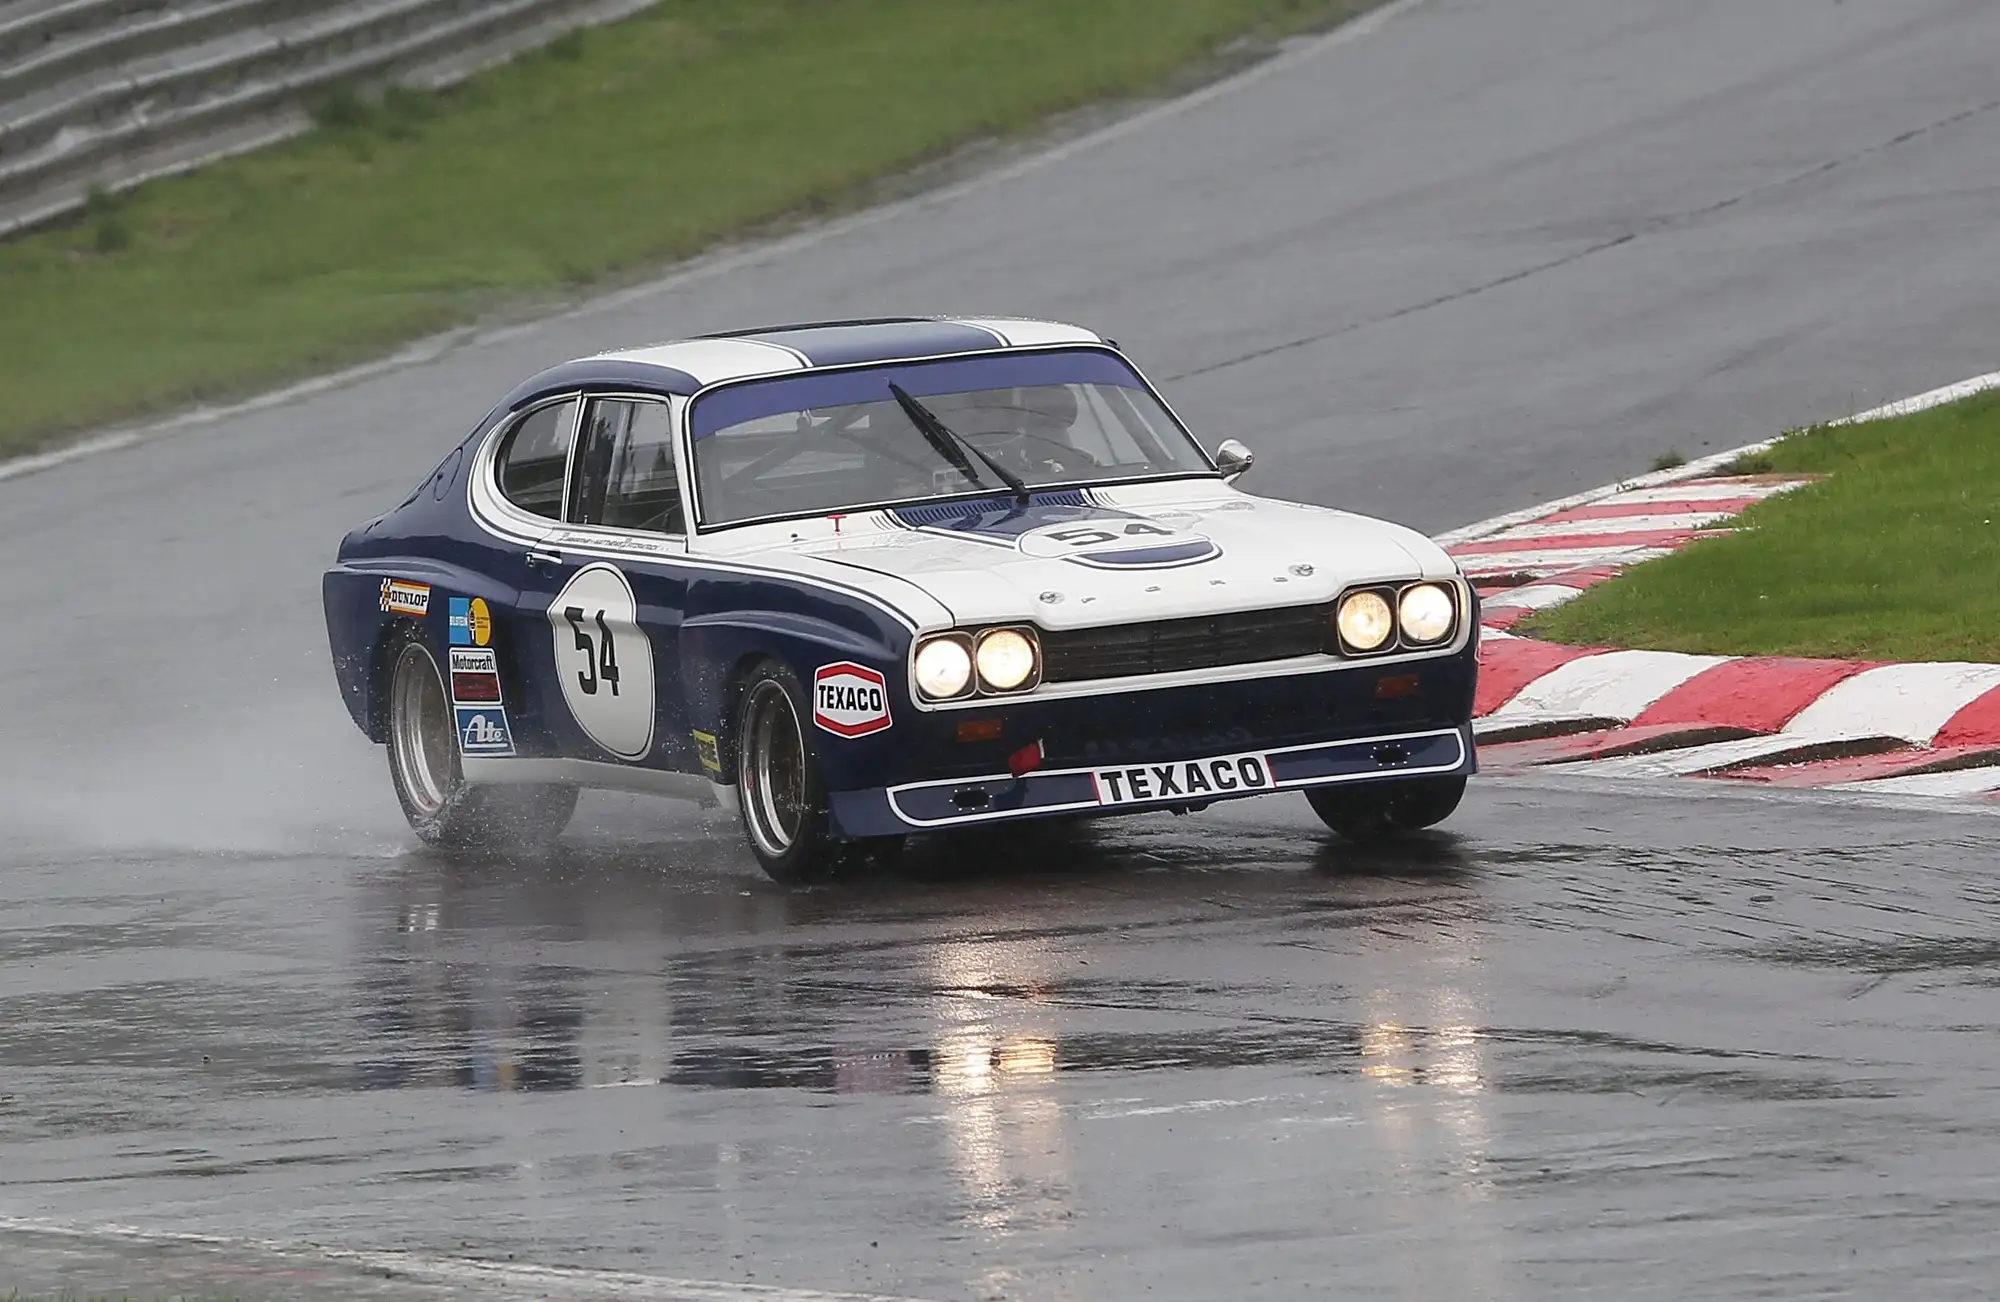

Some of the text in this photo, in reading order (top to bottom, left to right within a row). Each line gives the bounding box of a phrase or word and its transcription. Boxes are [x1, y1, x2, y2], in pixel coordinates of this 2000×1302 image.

[1043, 523, 1176, 546] 54
[391, 590, 428, 607] DUNLOP
[452, 654, 494, 670] Motorcraft
[564, 606, 619, 696] 54
[818, 685, 882, 711] TEXACO
[1100, 757, 1266, 801] TEXACO
